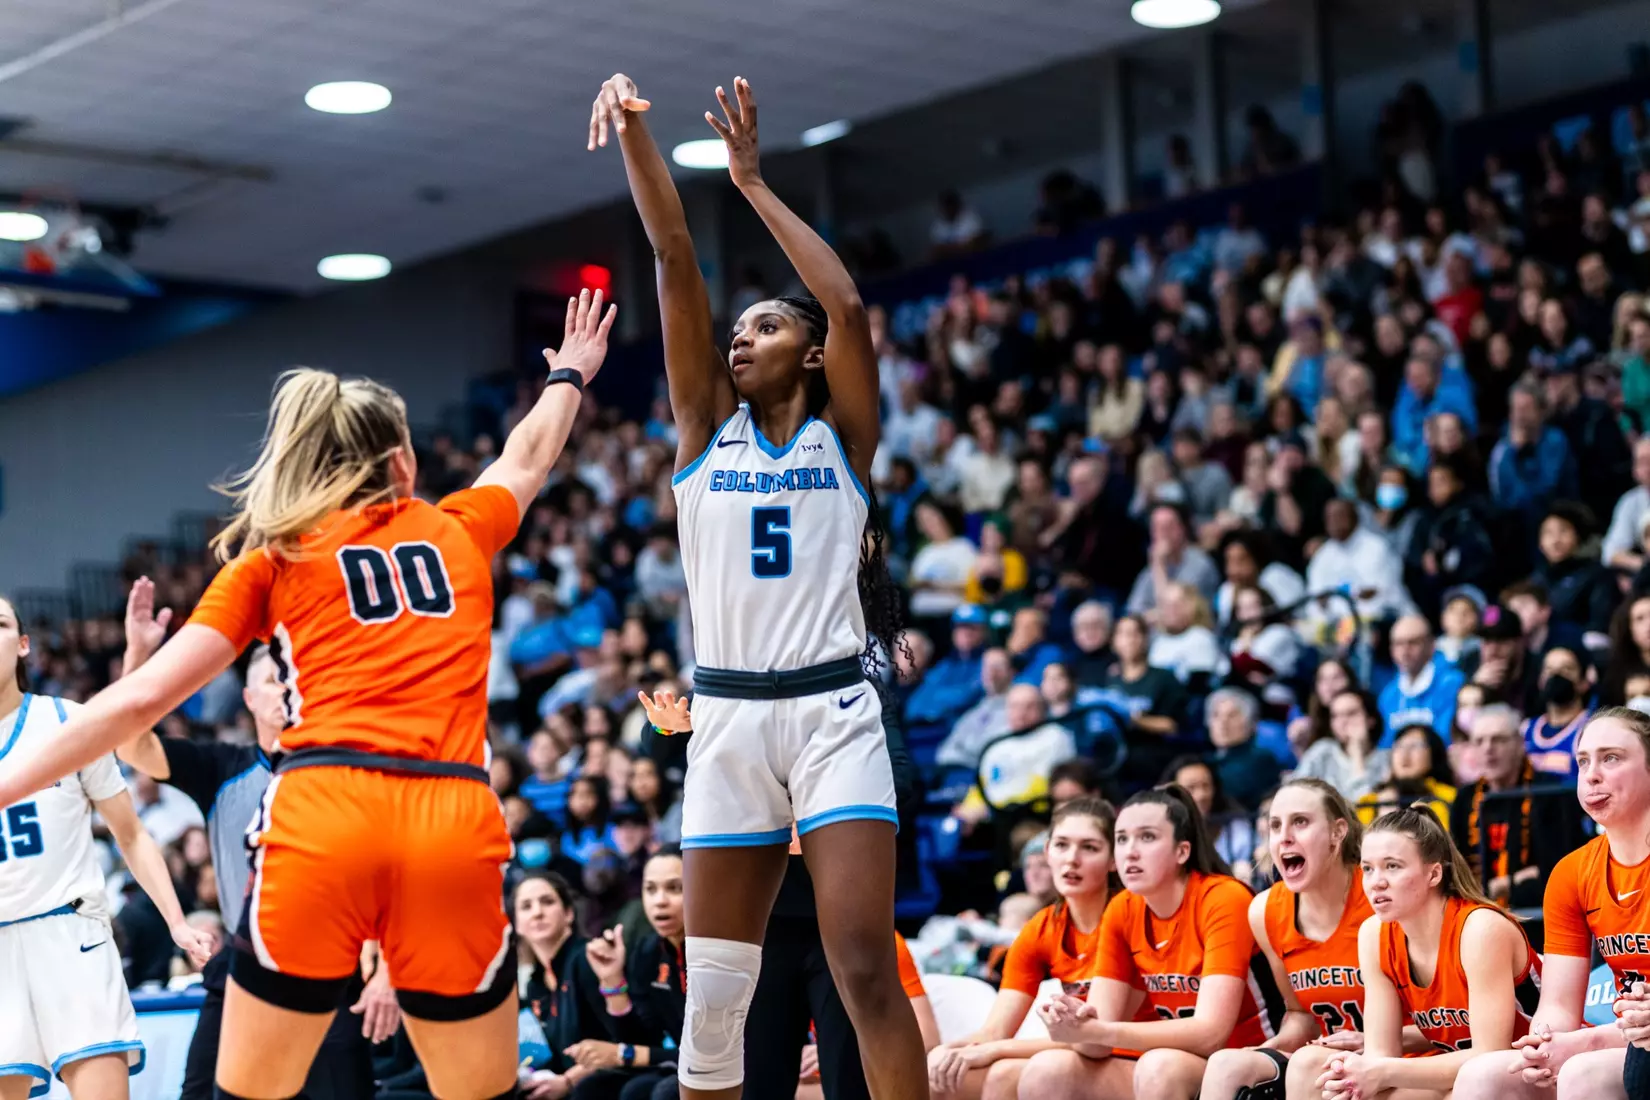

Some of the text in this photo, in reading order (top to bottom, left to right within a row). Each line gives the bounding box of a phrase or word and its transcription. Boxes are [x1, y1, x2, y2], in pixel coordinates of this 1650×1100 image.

[710, 468, 839, 494] COLUMBIA
[751, 506, 792, 579] 5
[336, 540, 456, 626] 00
[0, 800, 44, 864] 5
[1596, 933, 1650, 956] RINCE
[1289, 966, 1365, 992] RINCET
